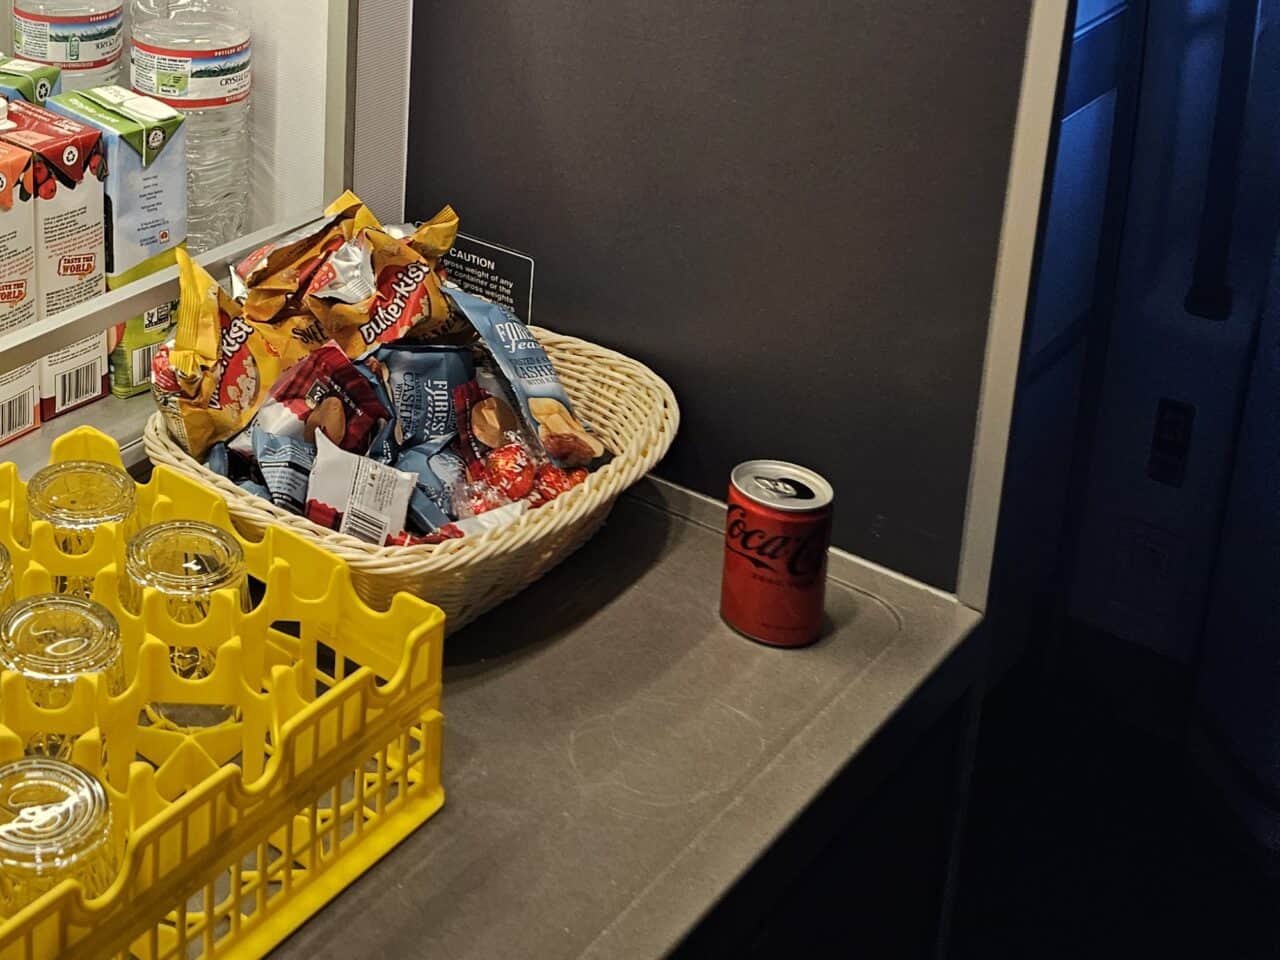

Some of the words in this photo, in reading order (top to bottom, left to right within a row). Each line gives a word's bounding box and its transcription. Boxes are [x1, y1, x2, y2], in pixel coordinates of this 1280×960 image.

[62, 262, 92, 274] WORLD
[64, 256, 82, 265] TASTE
[82, 255, 93, 263] THE
[449, 247, 496, 271] CAUTION
[443, 258, 464, 271] gross
[465, 265, 489, 280] weight
[490, 274, 499, 283] of
[499, 278, 514, 289] any
[12, 282, 24, 290] THE
[454, 271, 488, 287] container
[499, 286, 511, 295] the
